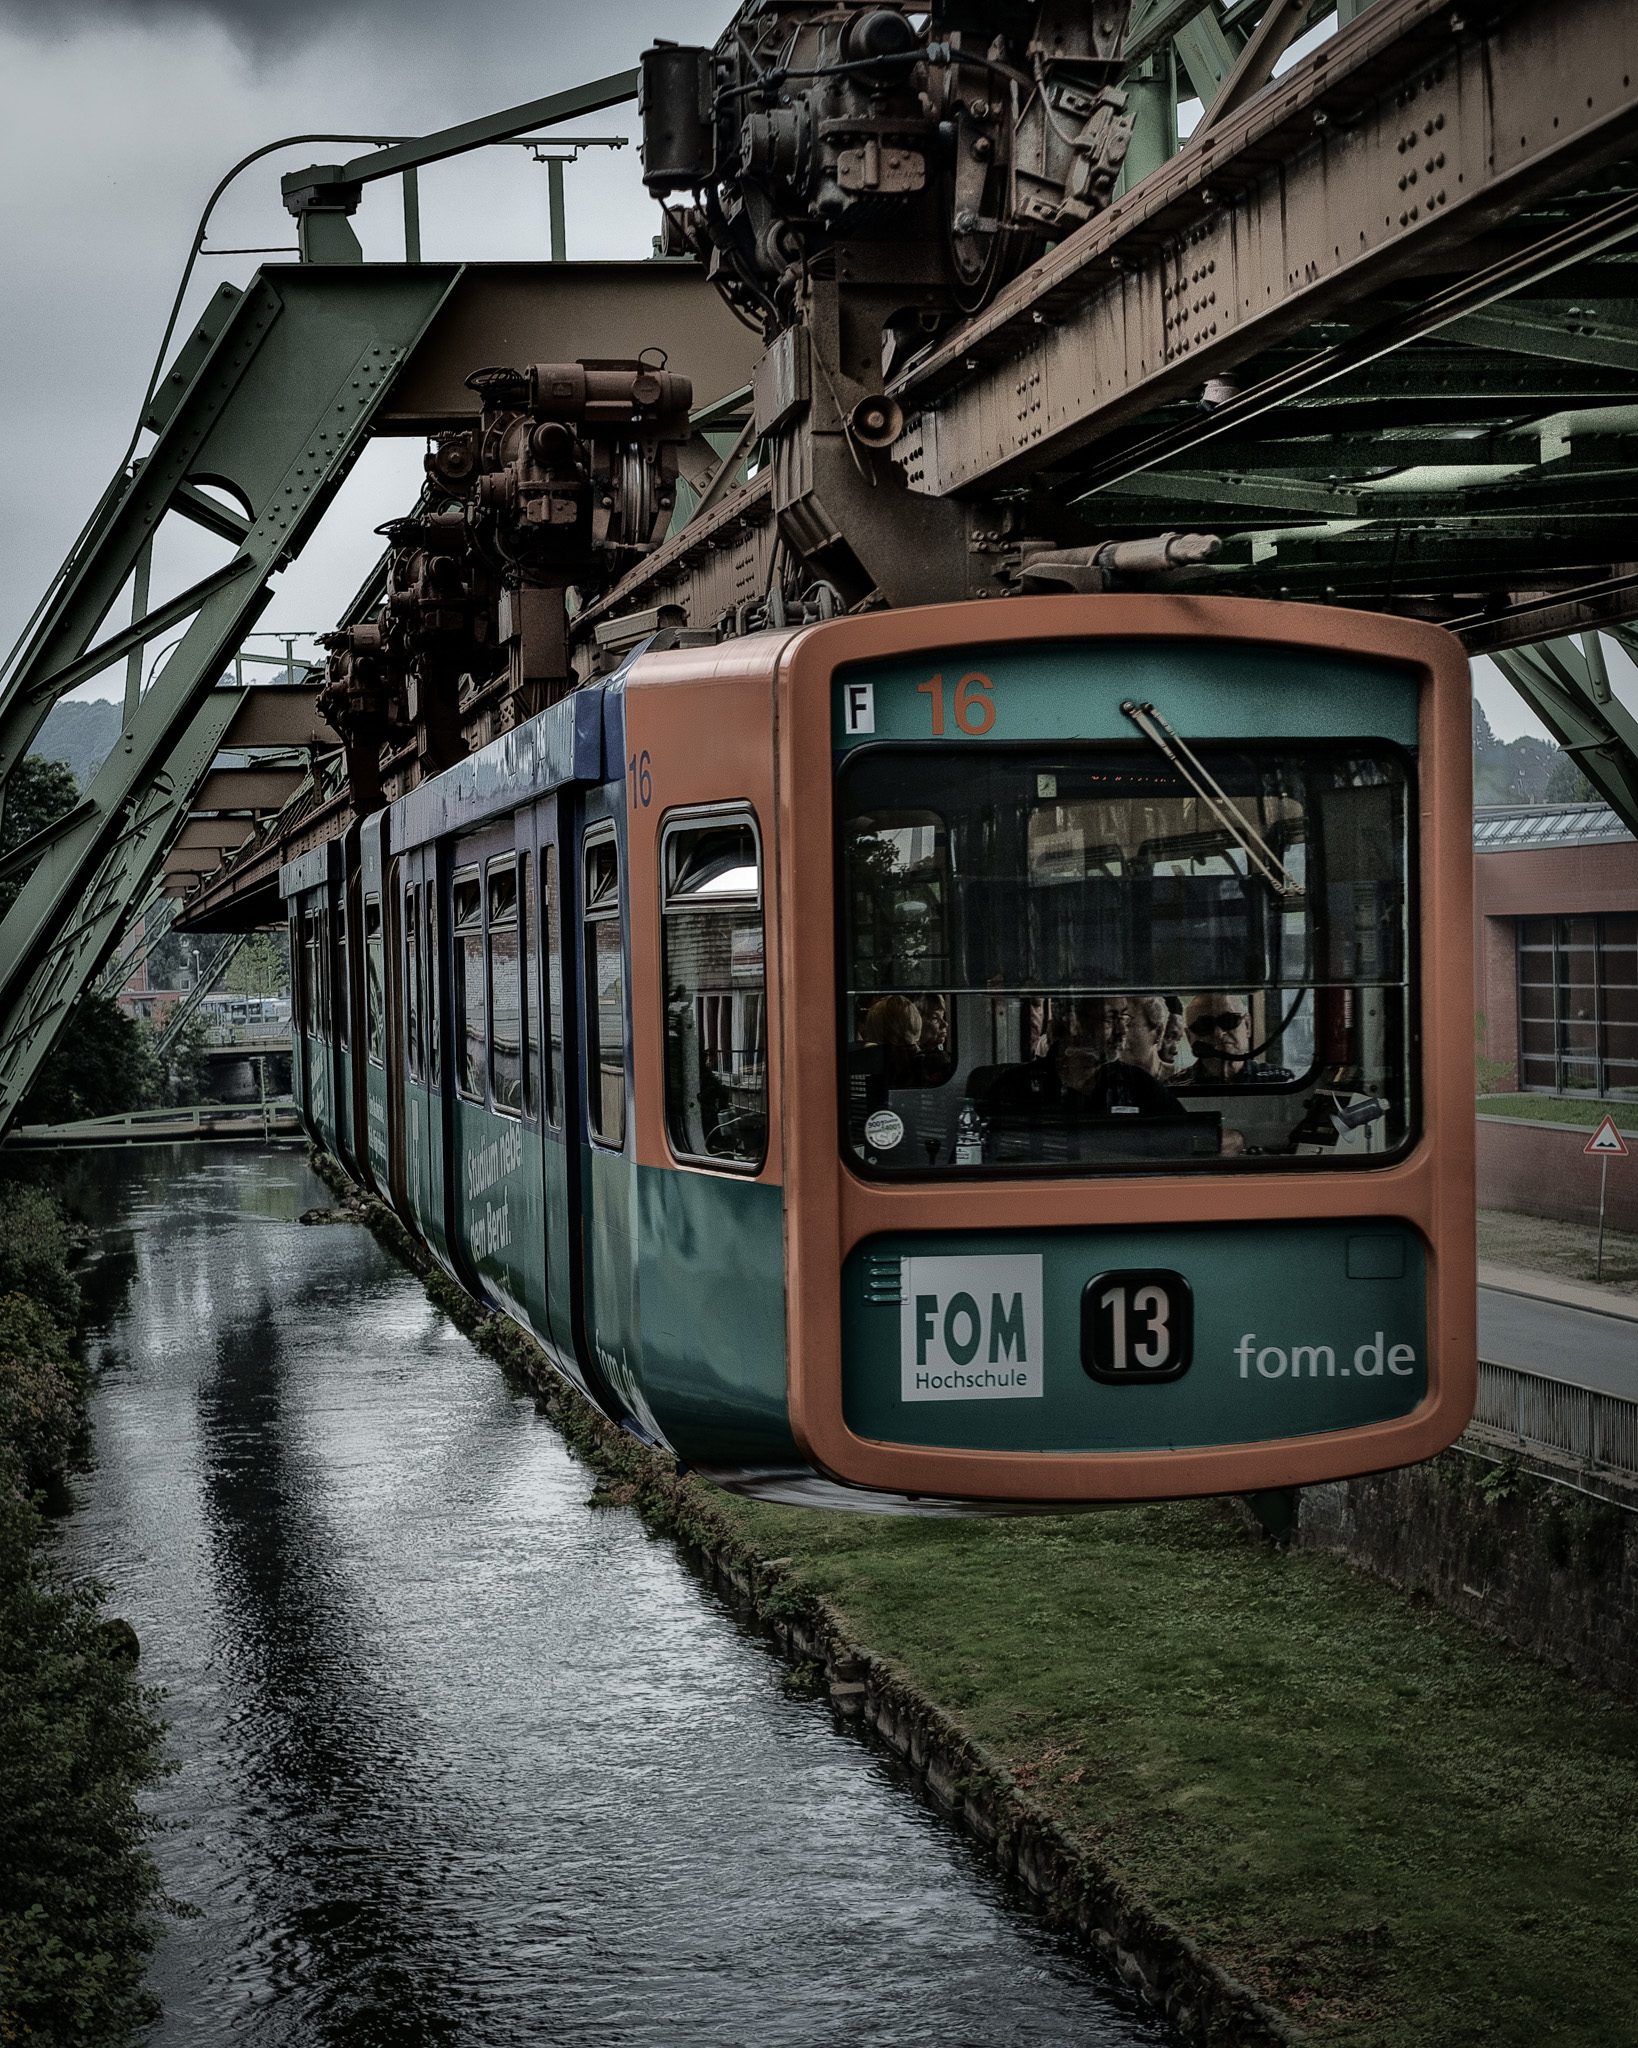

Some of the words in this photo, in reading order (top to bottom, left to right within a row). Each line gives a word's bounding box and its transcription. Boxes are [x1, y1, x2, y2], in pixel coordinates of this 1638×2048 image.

[850, 687, 867, 729] F
[917, 671, 996, 736] 16
[629, 750, 652, 809] 16
[468, 1134, 499, 1202] Studium
[470, 1208, 486, 1264] dem
[487, 1185, 512, 1255] Beruf.
[916, 1291, 1027, 1366] FOM
[1101, 1285, 1171, 1369] 13
[1233, 1331, 1416, 1379] fom.de
[916, 1368, 1027, 1389] Hochschule
